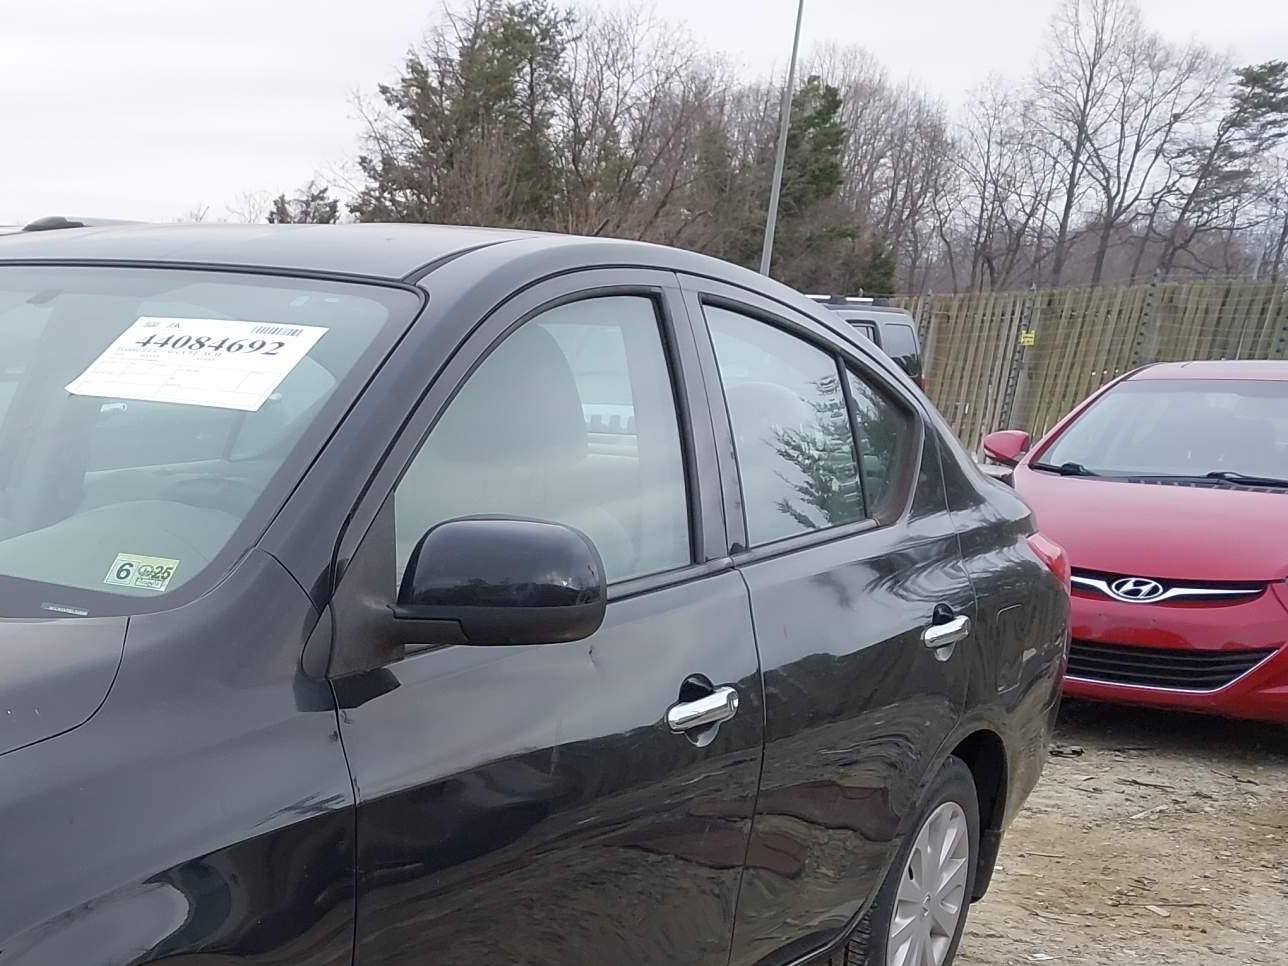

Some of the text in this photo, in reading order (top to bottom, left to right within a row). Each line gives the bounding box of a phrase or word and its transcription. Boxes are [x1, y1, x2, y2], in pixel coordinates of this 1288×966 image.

[135, 333, 286, 356] 44084692
[115, 562, 174, 580] 6 25
